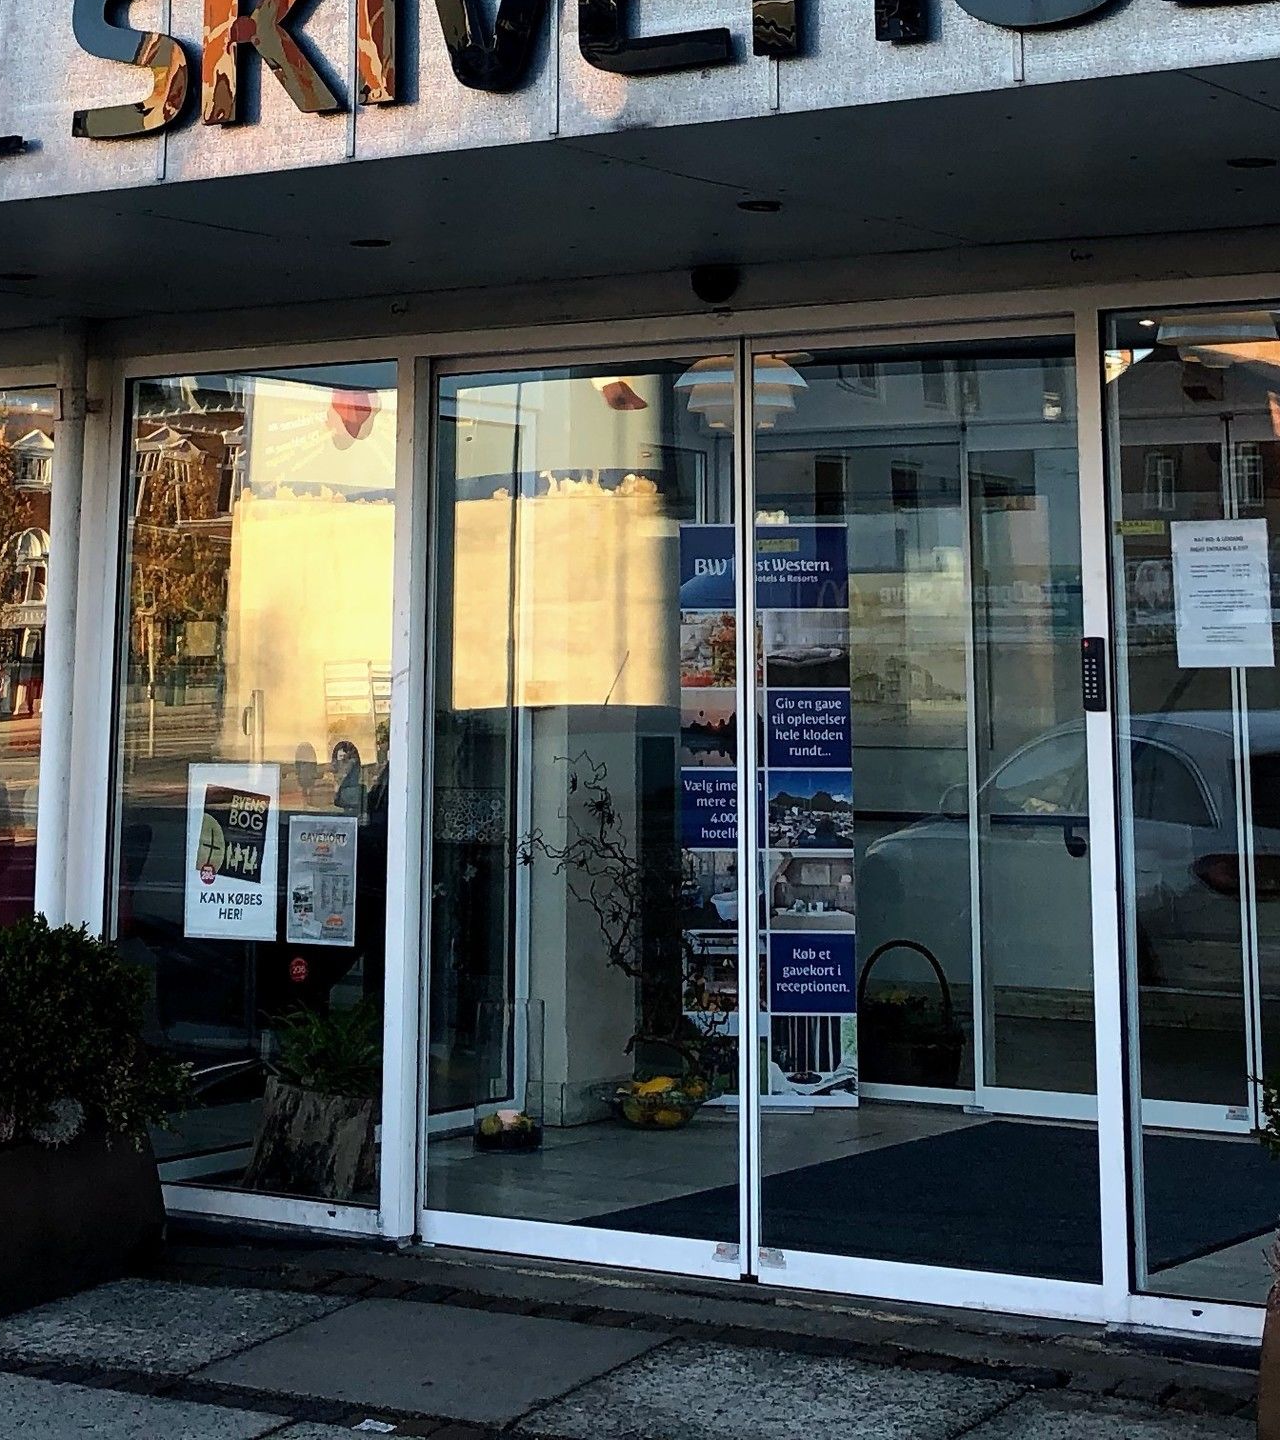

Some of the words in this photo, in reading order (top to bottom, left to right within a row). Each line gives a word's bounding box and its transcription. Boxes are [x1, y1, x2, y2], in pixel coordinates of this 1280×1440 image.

[694, 558, 727, 576] BW
[772, 558, 830, 572] Western
[787, 574, 819, 583] Resorts
[775, 697, 795, 709] Giv
[797, 700, 812, 709] en
[815, 700, 842, 711] gave
[772, 713, 785, 725] til
[787, 713, 846, 727] oplevelser
[775, 728, 800, 740] hele
[803, 729, 843, 741] kloden
[789, 744, 831, 756] rundt...
[684, 779, 713, 793] Vælg
[696, 798, 726, 807] mere
[229, 808, 264, 831] BOG
[300, 831, 347, 843] GAVEKORT
[200, 892, 225, 905] KAN
[228, 892, 263, 906] KØBES
[218, 907, 244, 920] HER!
[792, 948, 816, 960] Køb
[818, 950, 831, 960] et
[782, 964, 835, 978] gavekort
[837, 964, 842, 976] i
[776, 980, 851, 994] receptionen.
